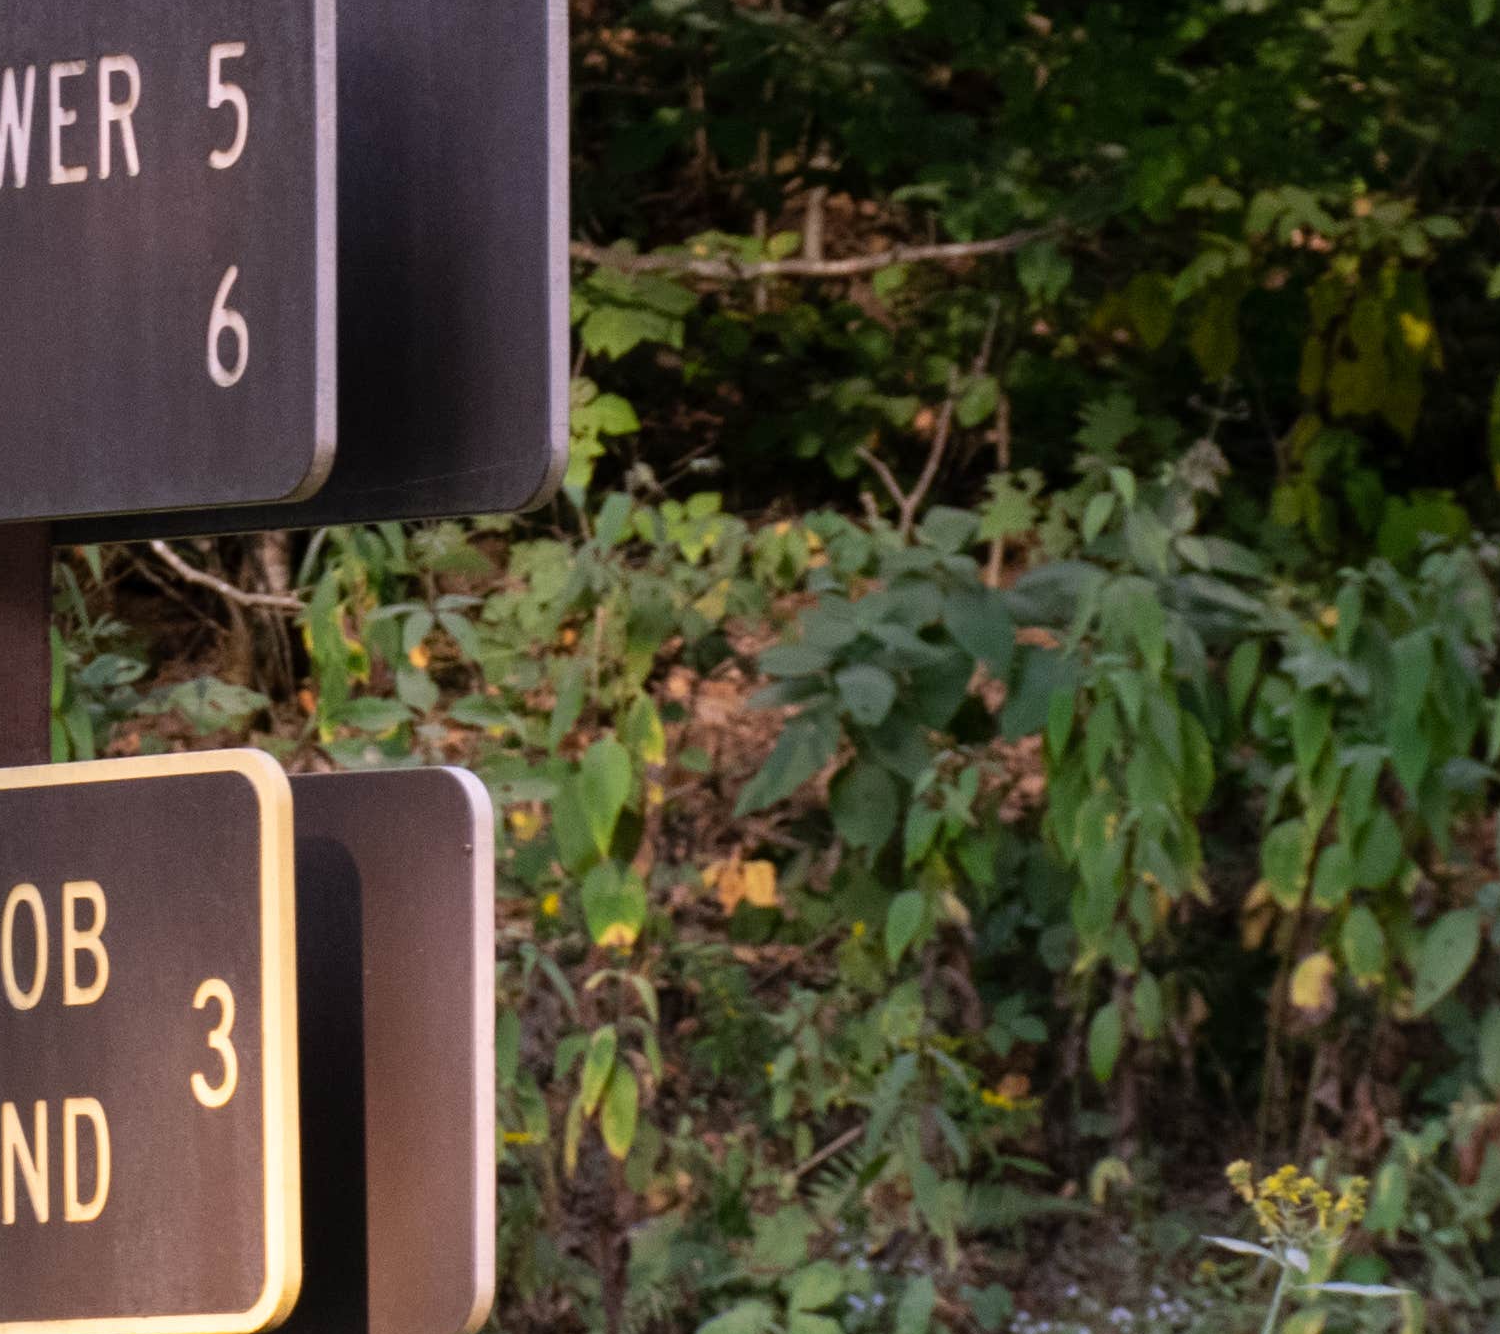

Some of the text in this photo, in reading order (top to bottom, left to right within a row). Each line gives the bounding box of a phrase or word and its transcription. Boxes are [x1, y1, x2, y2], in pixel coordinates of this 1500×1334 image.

[206, 41, 249, 171] 5
[206, 265, 249, 389] 6
[190, 978, 239, 1109] 3
